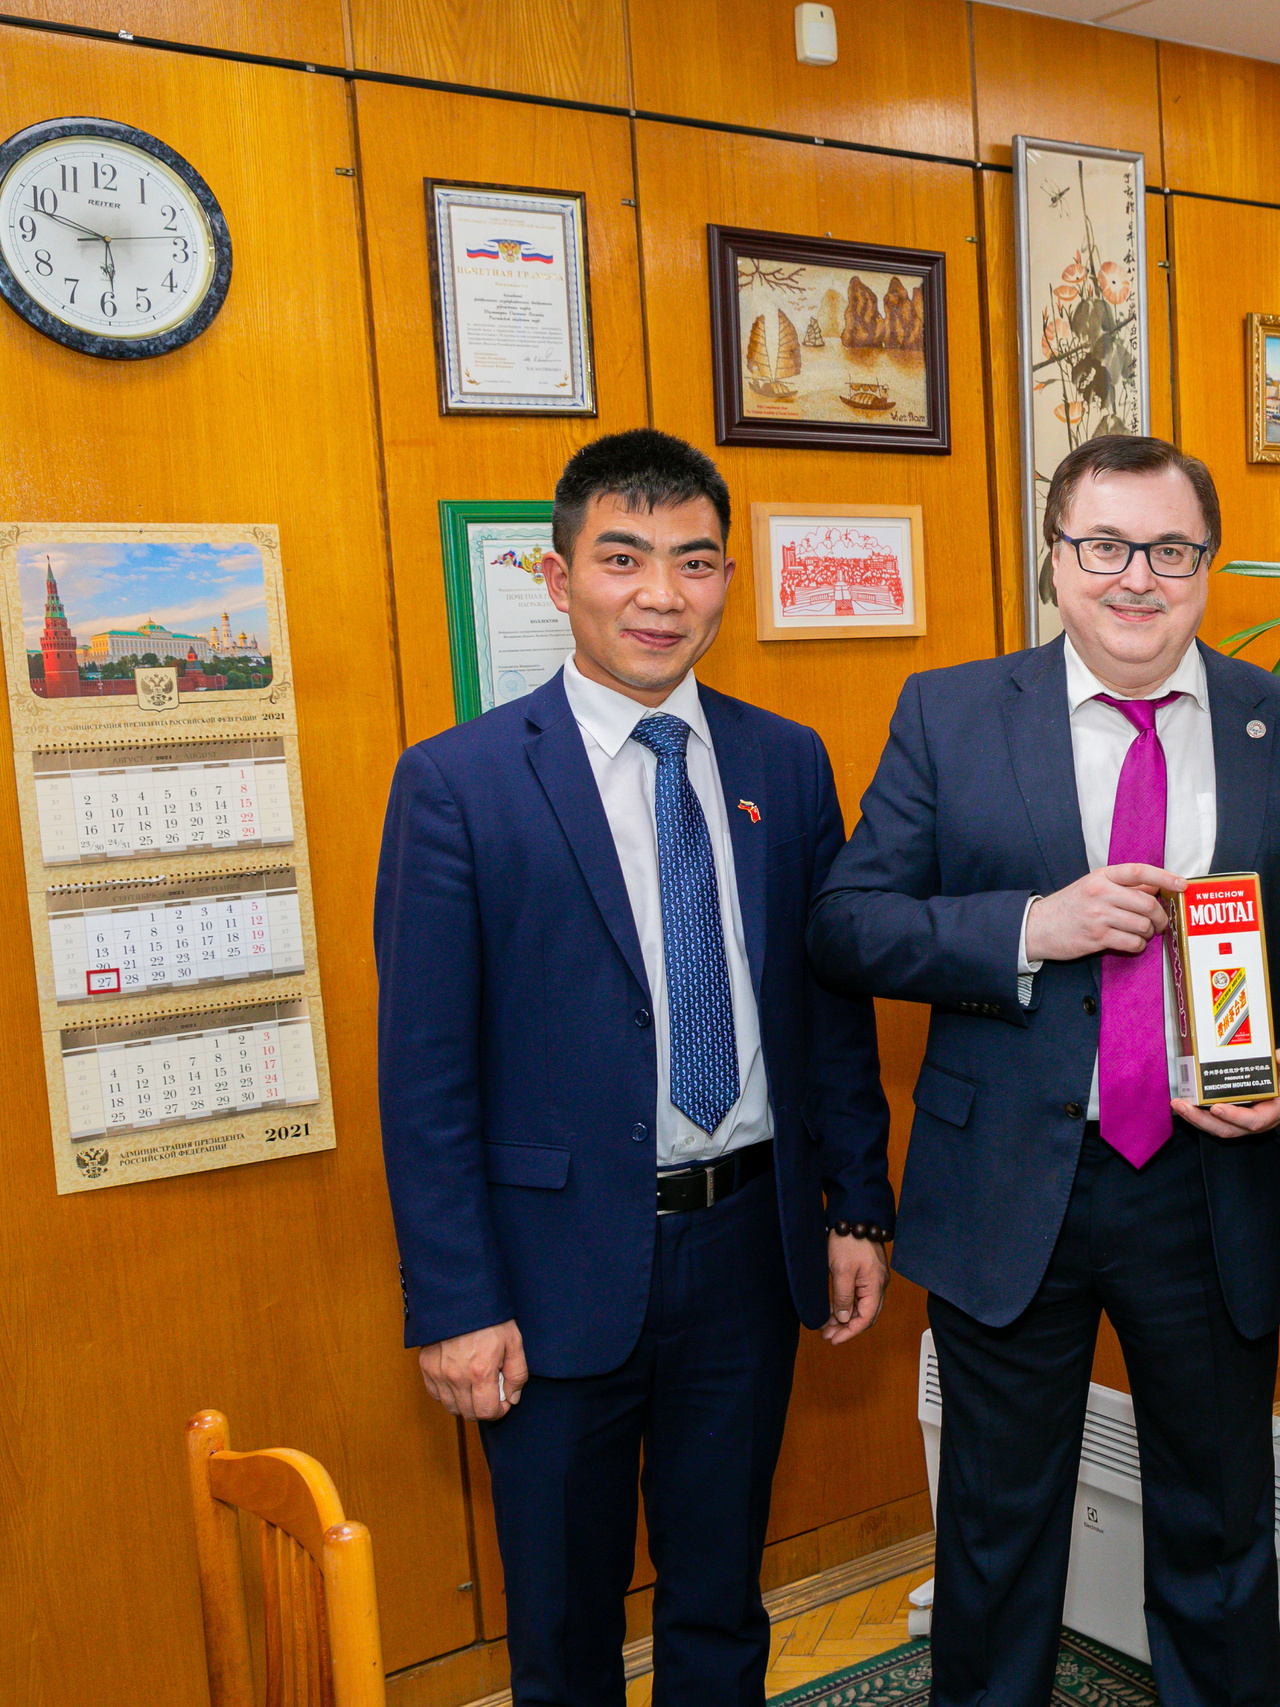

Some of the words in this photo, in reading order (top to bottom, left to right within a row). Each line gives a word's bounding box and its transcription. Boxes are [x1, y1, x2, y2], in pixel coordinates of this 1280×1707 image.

[60, 165, 78, 194] 11
[92, 162, 118, 192] 12
[32, 185, 58, 215] 10
[88, 199, 121, 209] REITER
[139, 178, 147, 205] 1
[19, 216, 36, 242] 9
[161, 205, 177, 232] 2
[35, 249, 54, 276] 8
[173, 238, 188, 264] 3
[161, 268, 178, 294] 4
[457, 266, 513, 278] ПОЧЕТНАЯ
[517, 270, 564, 282] ГРАМОТА
[64, 278, 79, 304] 7
[100, 291, 117, 317] 6
[135, 287, 152, 313] 5
[123, 719, 168, 728] ПРЕЗИДЕНТА
[169, 716, 216, 726] РОССИЙСКОЙ
[217, 714, 257, 724] ФЕДЕРАЦИИ
[261, 712, 286, 721] 2021
[113, 756, 144, 764] АВГУСТ
[185, 752, 217, 760] AUGUST
[240, 770, 245, 779] 1
[84, 795, 91, 805] 2
[111, 793, 119, 803] 3
[138, 792, 145, 801] 4
[165, 790, 172, 800] 5
[190, 788, 197, 797] 6
[216, 786, 222, 795] 7
[241, 784, 248, 794] 8
[85, 811, 93, 820] 9
[111, 808, 124, 818] 10
[138, 806, 149, 816] 11
[164, 804, 176, 814] 12
[190, 802, 202, 812] 13
[215, 800, 227, 810] 14
[240, 799, 252, 808] 15
[85, 825, 98, 835] 16
[112, 823, 124, 833] 17
[139, 821, 152, 831] 18
[165, 819, 178, 829] 19
[190, 817, 204, 827] 20
[216, 815, 227, 825] 21
[241, 813, 254, 823] 22
[81, 841, 104, 851] 23/30
[108, 839, 130, 849] 24/31
[139, 836, 153, 846] 25
[166, 834, 180, 844] 26
[192, 832, 205, 841] 27
[217, 829, 230, 839] 28
[242, 827, 255, 837] 29
[113, 893, 157, 902] СЕНТЯБРЬ
[1196, 890, 1244, 900] KWEICHOW
[151, 913, 155, 922] 1
[175, 910, 182, 919] 2
[201, 907, 208, 917] 3
[227, 905, 233, 913] 4
[252, 902, 258, 911] 5
[1189, 901, 1255, 926] MOUTAI
[97, 933, 104, 943] 6
[124, 930, 131, 940] 7
[151, 927, 158, 937] 8
[177, 925, 184, 934] 9
[201, 921, 213, 931] 10
[226, 919, 237, 928] 11
[250, 916, 263, 925] 12
[96, 948, 109, 958] 13
[123, 945, 136, 955] 14
[150, 942, 163, 952] 15
[176, 939, 189, 949] 16
[202, 936, 214, 946] 17
[227, 933, 239, 943] 18
[252, 930, 264, 940] 19
[124, 960, 136, 970] 21
[150, 956, 164, 966] 22
[176, 953, 190, 963] 23
[202, 951, 215, 960] 24
[227, 948, 240, 957] 25
[252, 944, 266, 954] 26
[98, 977, 112, 988] 27
[125, 974, 139, 984] 28
[152, 971, 165, 981] 29
[178, 968, 191, 978] 30
[131, 1027, 169, 1037] ОКТЯБРЬ
[214, 1039, 219, 1048] 1
[239, 1035, 245, 1045] 2
[264, 1032, 270, 1041] 3
[110, 1069, 117, 1078] 4
[137, 1065, 144, 1075] 5
[163, 1061, 171, 1070] 6
[189, 1057, 196, 1067] 7
[215, 1053, 222, 1063] 8
[240, 1050, 247, 1059] 9
[262, 1045, 275, 1056] 10
[110, 1083, 121, 1093] 11
[137, 1079, 149, 1089] 12
[163, 1075, 175, 1085] 13
[189, 1071, 201, 1081] 14
[215, 1067, 227, 1077] 15
[240, 1063, 252, 1073] 16
[264, 1060, 276, 1070] 17
[1204, 1083, 1232, 1091] KWEICHOW
[1232, 1081, 1251, 1089] MOUTAI
[111, 1098, 124, 1108] 18
[138, 1094, 151, 1104] 19
[163, 1089, 177, 1100] 20
[189, 1086, 202, 1096] 21
[215, 1081, 228, 1092] 22
[240, 1077, 253, 1088] 23
[265, 1074, 277, 1084] 24
[111, 1112, 126, 1123] 25
[138, 1108, 152, 1119] 26
[165, 1104, 178, 1114] 27
[191, 1100, 205, 1110] 28
[217, 1096, 230, 1106] 29
[242, 1092, 255, 1102] 30
[267, 1088, 278, 1098] 31
[119, 1141, 193, 1159] АДМИНИСТРАЦИЯ
[194, 1133, 245, 1149] ПРЕЗИДЕНТА
[265, 1123, 311, 1143] 2021
[119, 1152, 176, 1167] РОССИЙСКОЙ
[178, 1144, 227, 1157] ФЕДЕРАЦИИ
